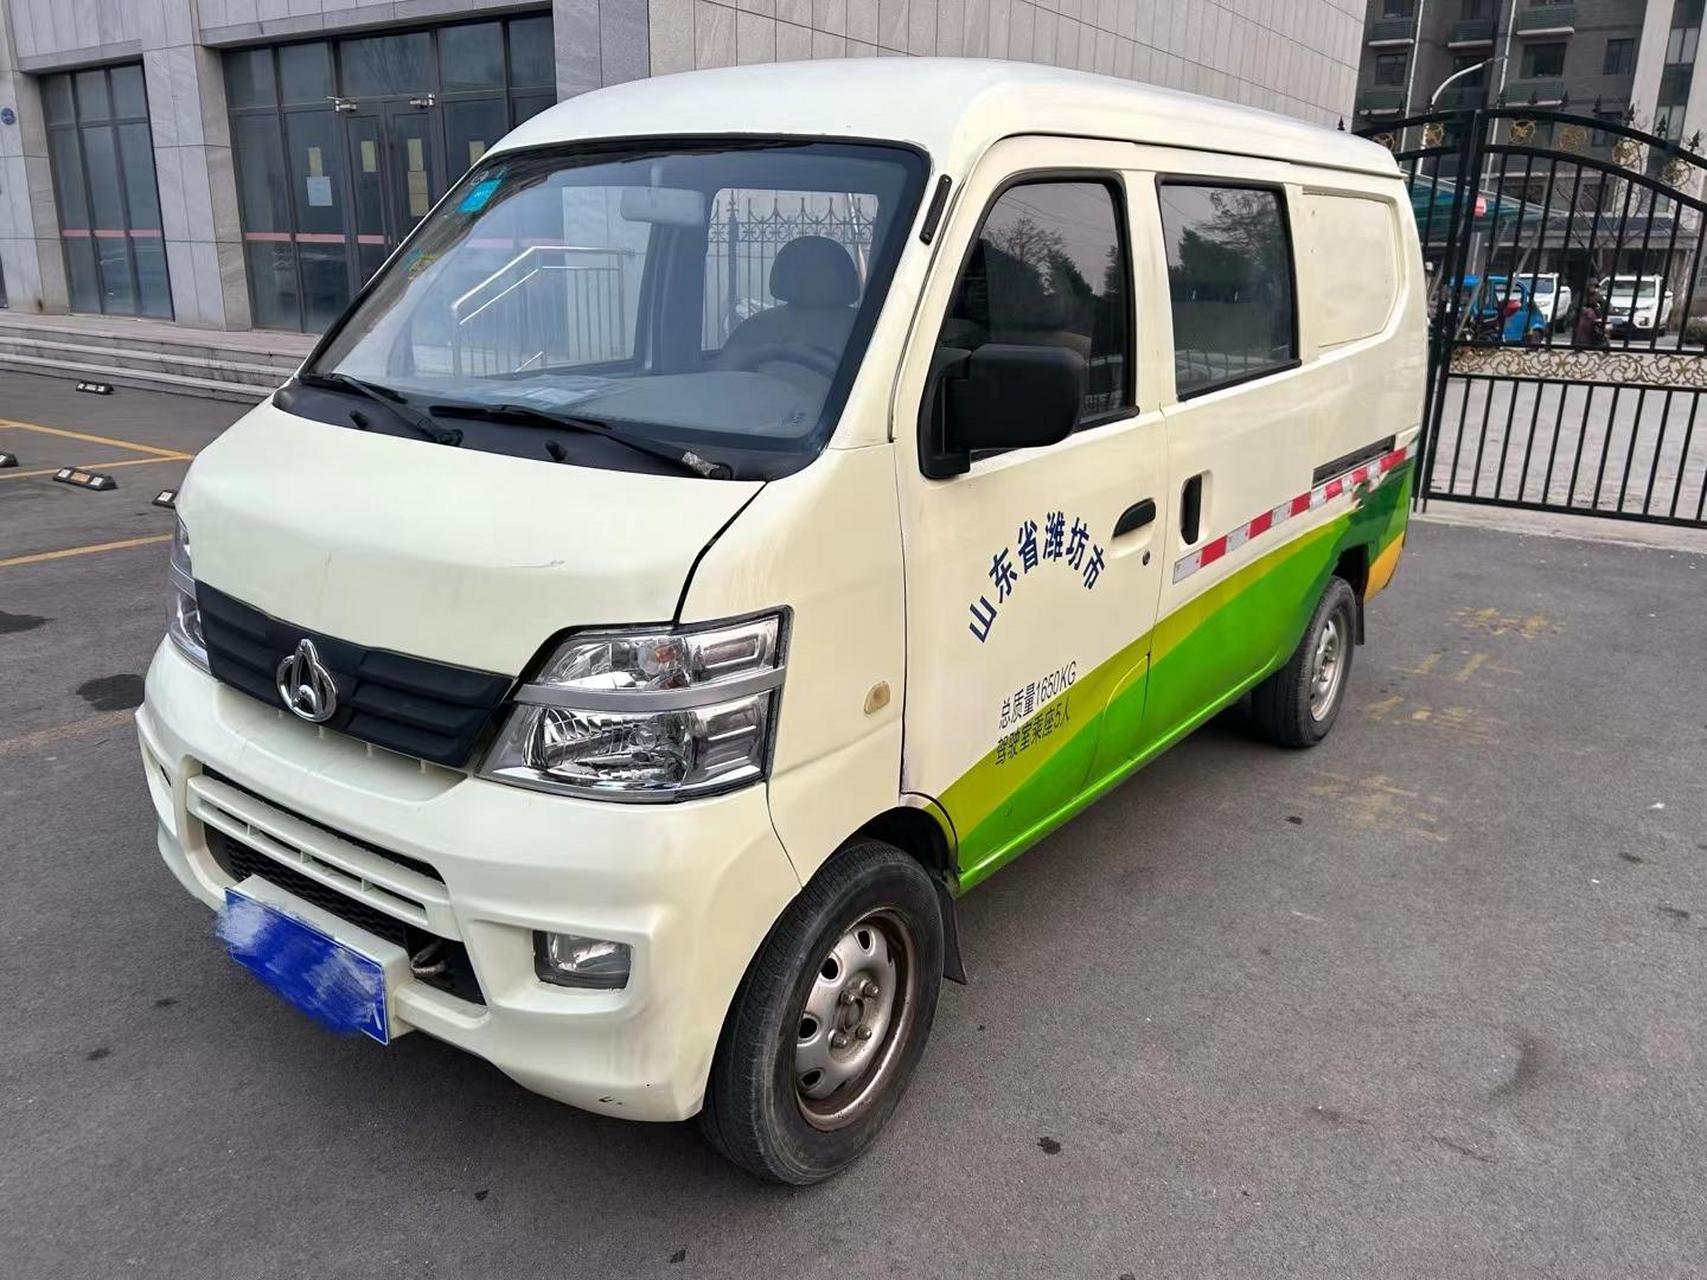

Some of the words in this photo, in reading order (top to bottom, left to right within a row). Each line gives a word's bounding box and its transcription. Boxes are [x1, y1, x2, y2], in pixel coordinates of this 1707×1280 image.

[969, 510, 1105, 643] 山东省潍坊市
[999, 660, 1076, 729] 总质量1650KG
